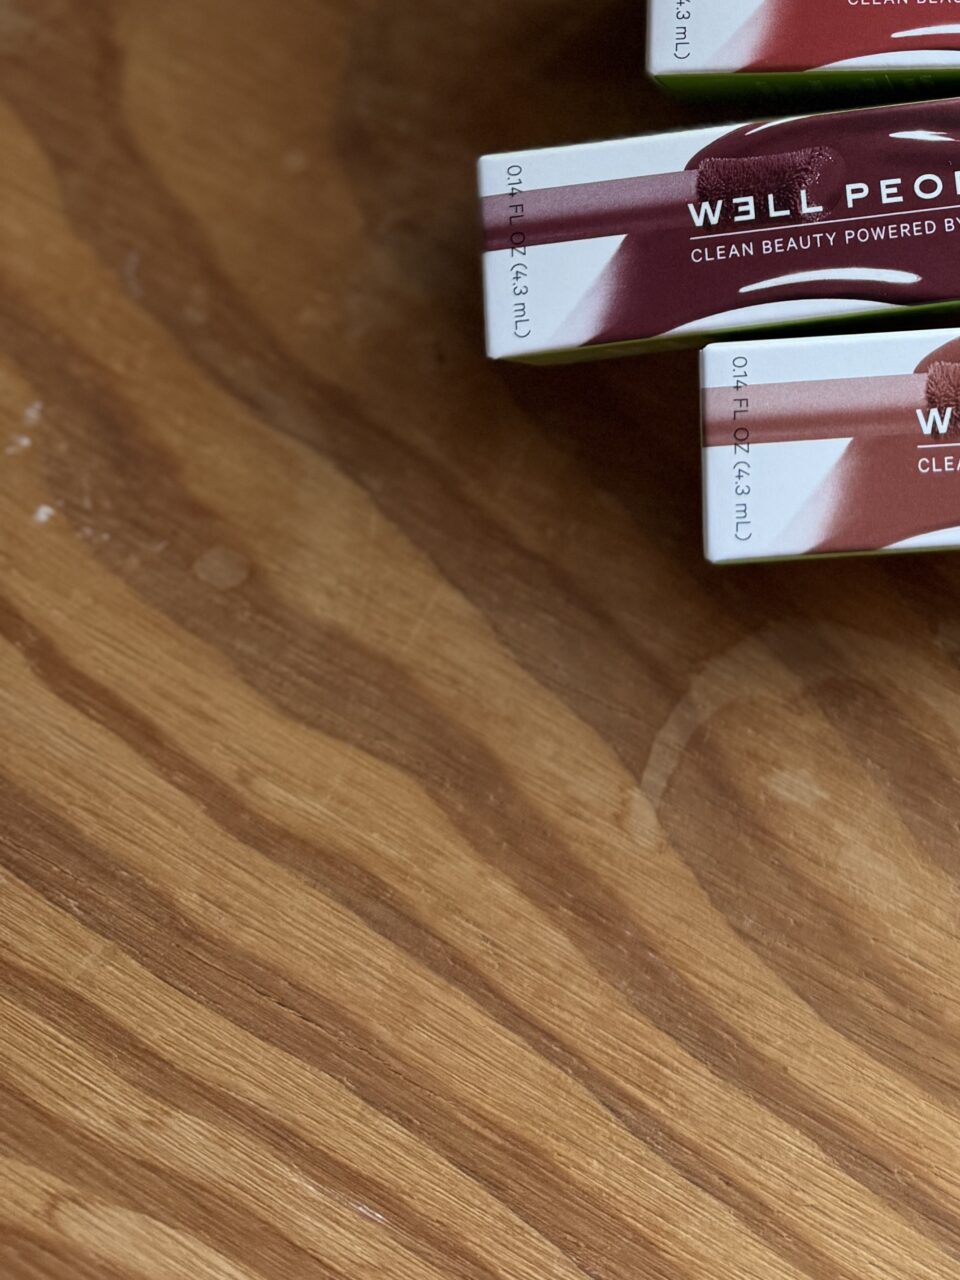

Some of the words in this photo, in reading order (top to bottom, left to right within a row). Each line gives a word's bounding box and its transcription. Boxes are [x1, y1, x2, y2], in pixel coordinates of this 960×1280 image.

[674, 27, 690, 60] mL)
[507, 165, 525, 197] 0.14
[508, 204, 524, 225] FL
[510, 232, 526, 257] OZ
[691, 243, 754, 262] CLEAN
[762, 232, 836, 254] BEAUTY
[845, 220, 936, 244] POWERED
[511, 263, 528, 297] (4.3
[513, 303, 531, 338] mL)
[732, 356, 748, 391] 0.14
[732, 398, 748, 420] FL
[734, 427, 749, 455] OZ
[734, 461, 751, 496] (4.3
[735, 503, 752, 541] mL)
